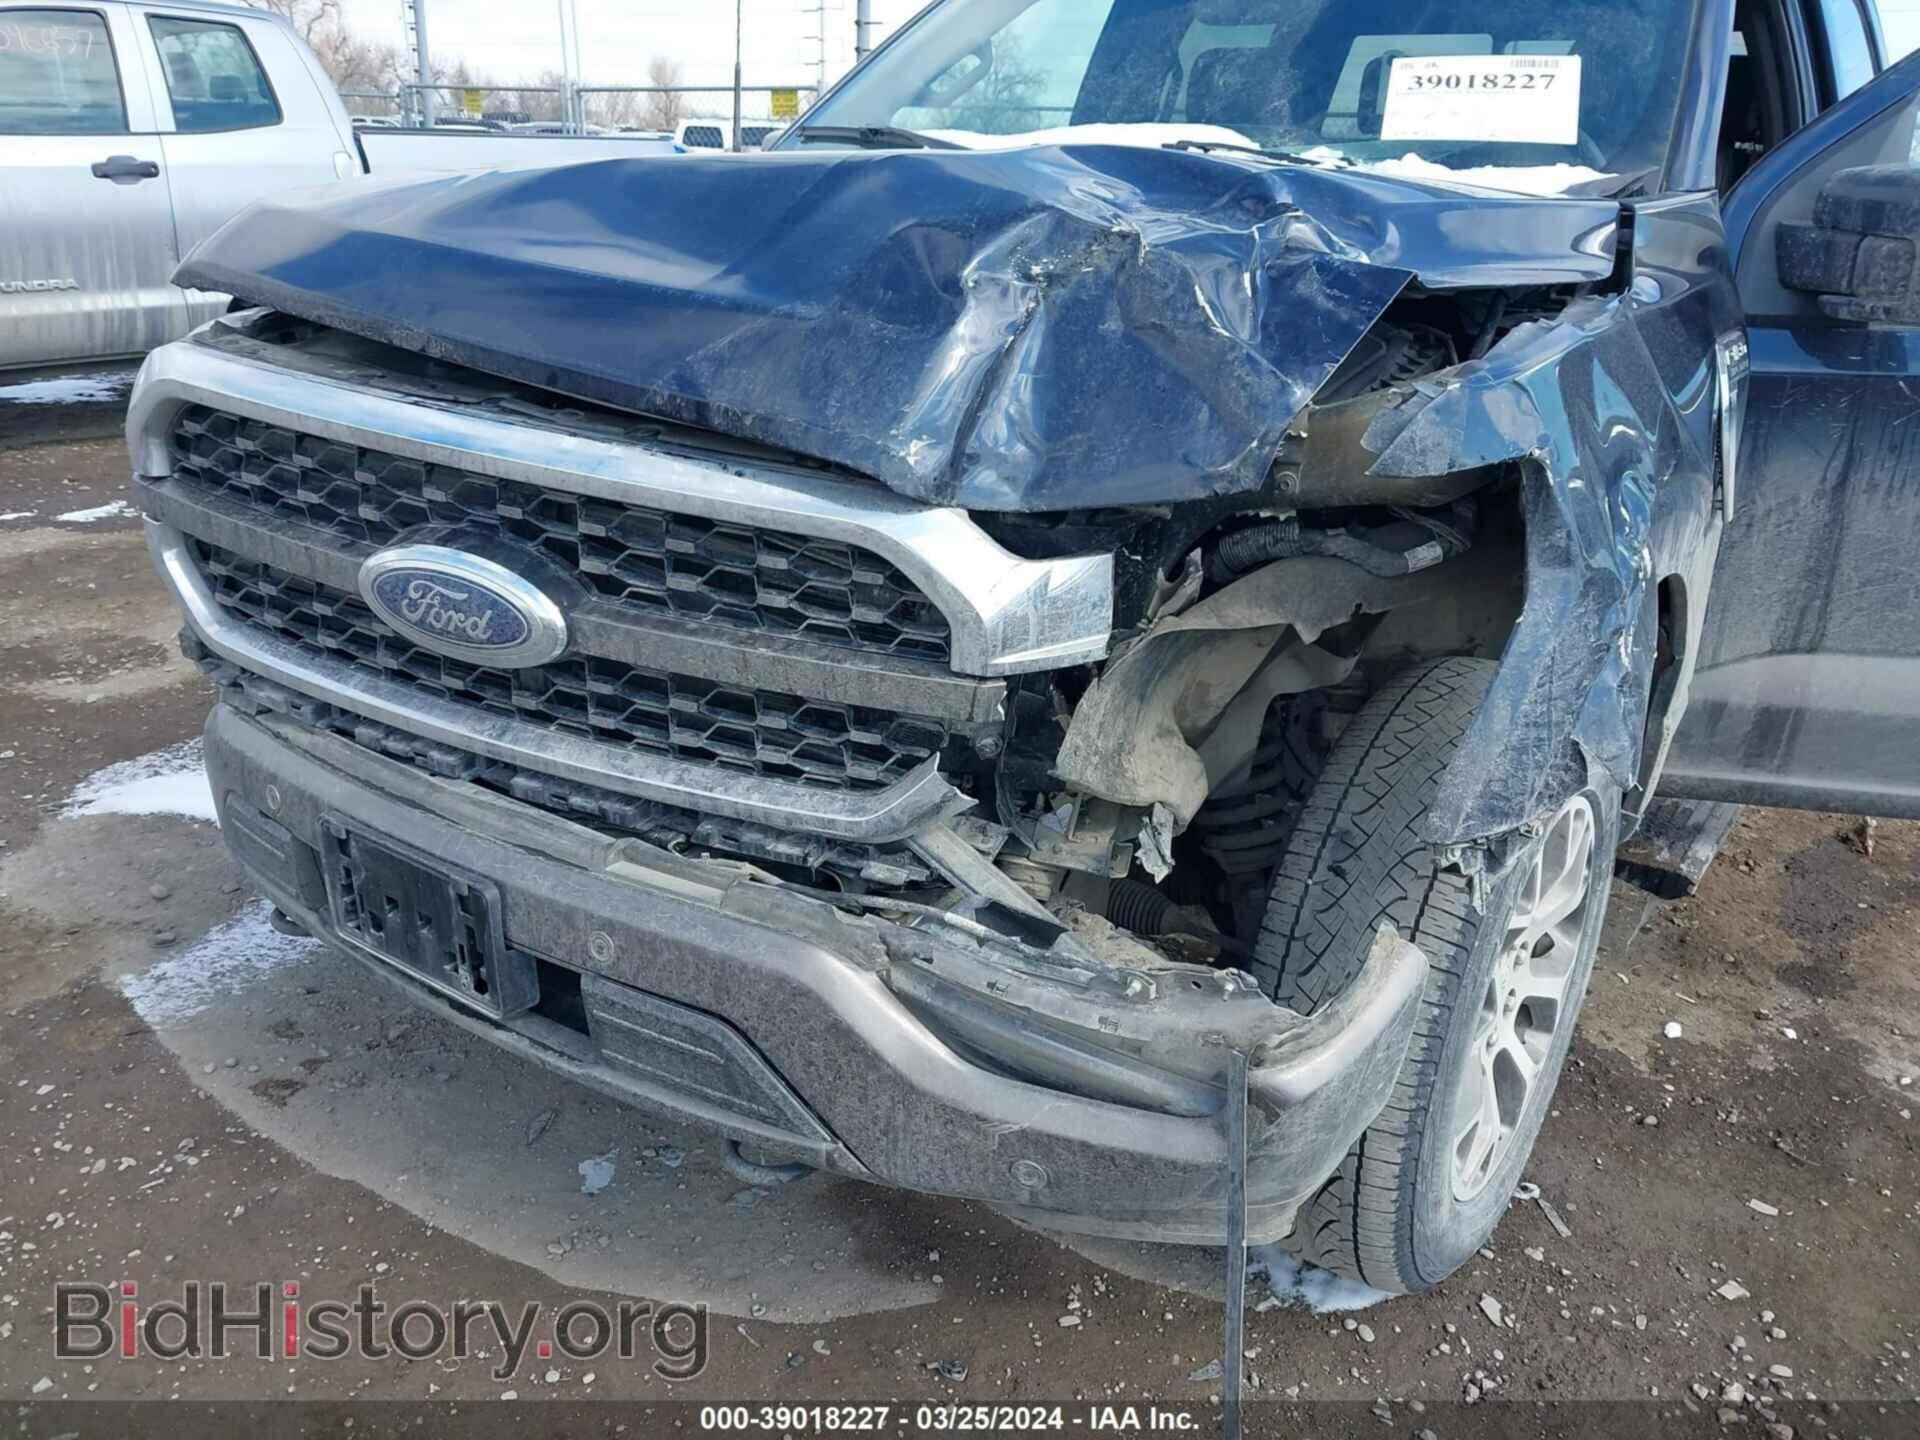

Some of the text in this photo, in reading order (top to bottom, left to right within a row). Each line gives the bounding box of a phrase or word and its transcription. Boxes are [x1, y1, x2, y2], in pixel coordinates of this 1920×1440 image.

[1407, 73, 1556, 90] 39018227
[0, 278, 80, 294] UNDRA
[401, 579, 493, 640] Ford
